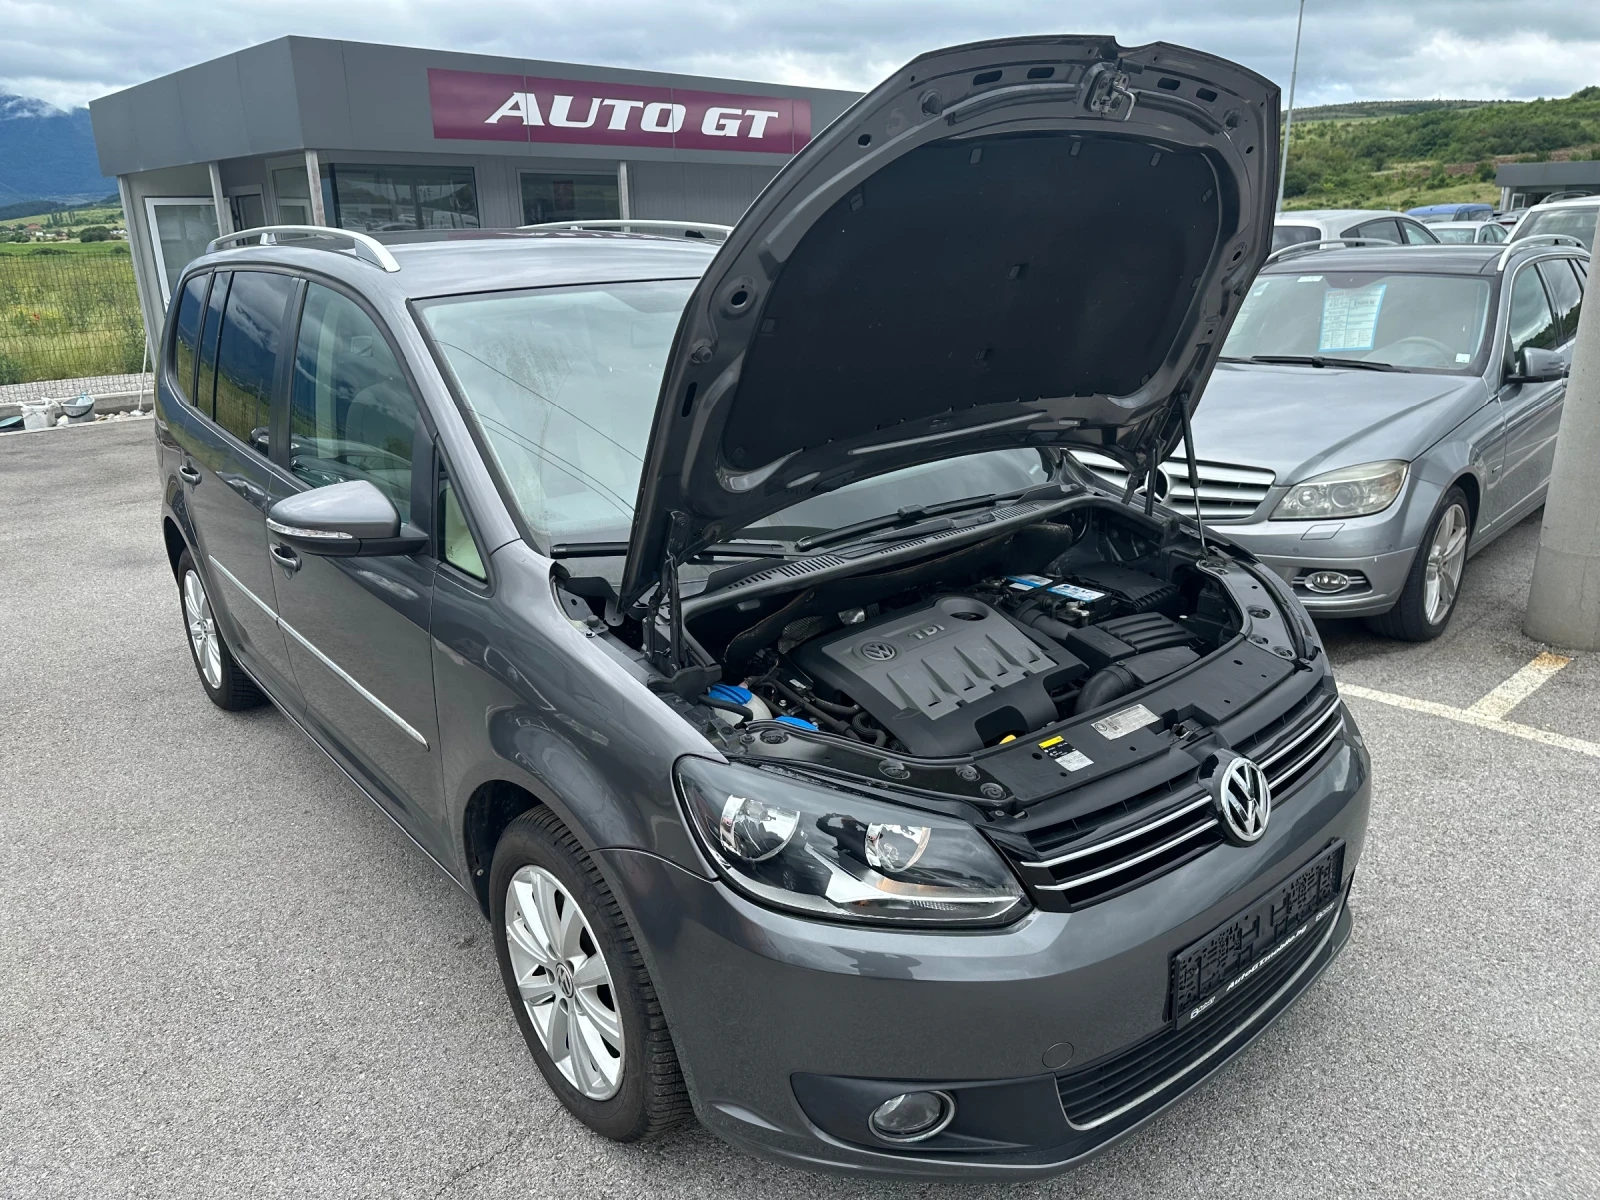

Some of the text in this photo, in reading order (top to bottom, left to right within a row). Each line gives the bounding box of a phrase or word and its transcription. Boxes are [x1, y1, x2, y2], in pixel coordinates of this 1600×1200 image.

[485, 92, 779, 138] AUTO GT
[908, 624, 945, 640] TDI
